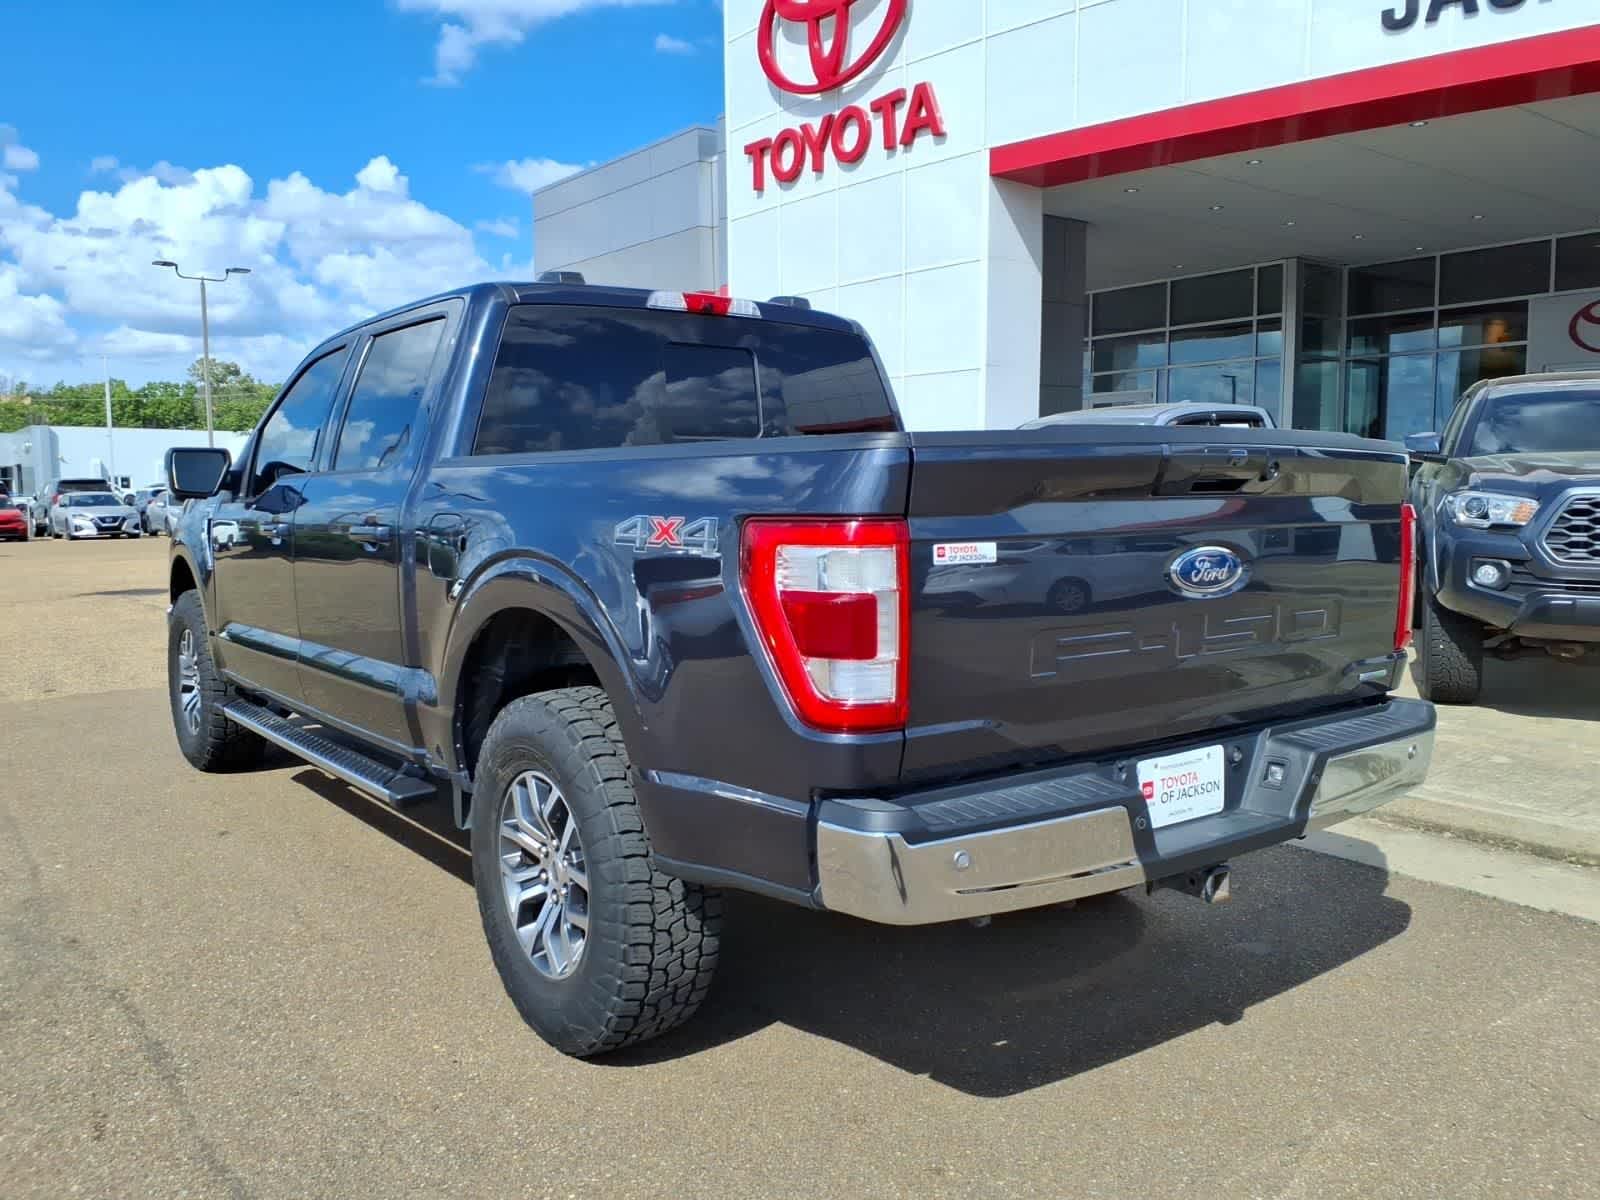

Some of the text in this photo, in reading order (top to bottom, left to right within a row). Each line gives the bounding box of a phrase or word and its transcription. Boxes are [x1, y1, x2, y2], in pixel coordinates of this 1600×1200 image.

[744, 82, 945, 192] TOYOTA
[948, 545, 978, 554] TOYOTA
[1191, 556, 1230, 582] Ford
[1160, 771, 1198, 790] TOYOTA
[1160, 780, 1220, 804] OF JACKSON
